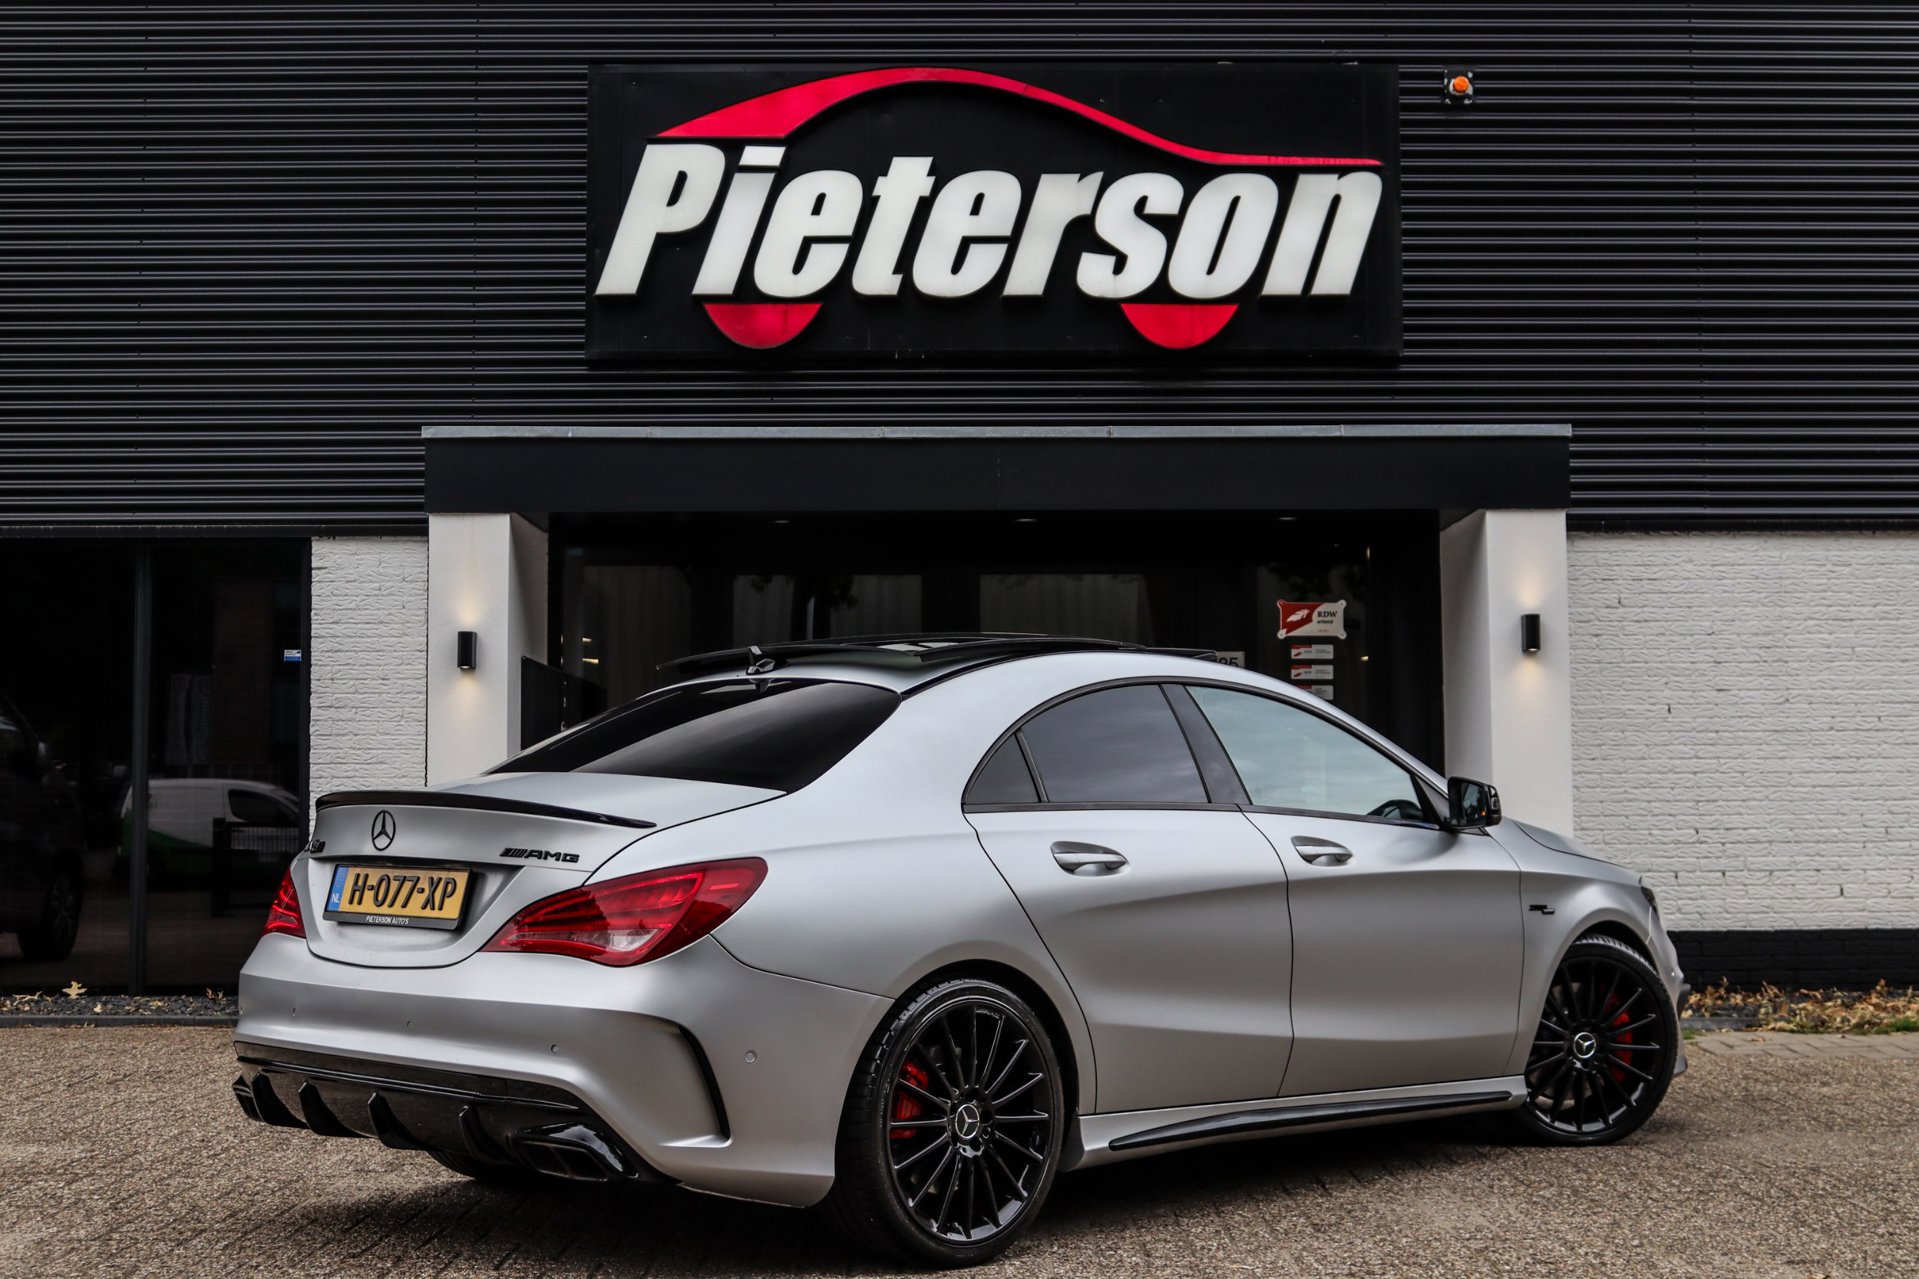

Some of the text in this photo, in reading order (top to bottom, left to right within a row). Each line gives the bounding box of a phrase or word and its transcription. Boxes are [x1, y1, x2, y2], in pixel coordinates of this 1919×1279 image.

[594, 143, 1384, 299] Pieterson
[1317, 610, 1338, 618] RDW
[524, 849, 580, 863] AMG
[348, 872, 457, 911] H-077-XP
[331, 893, 340, 904] NL
[366, 915, 409, 925] PIETERSON AUTO'S
